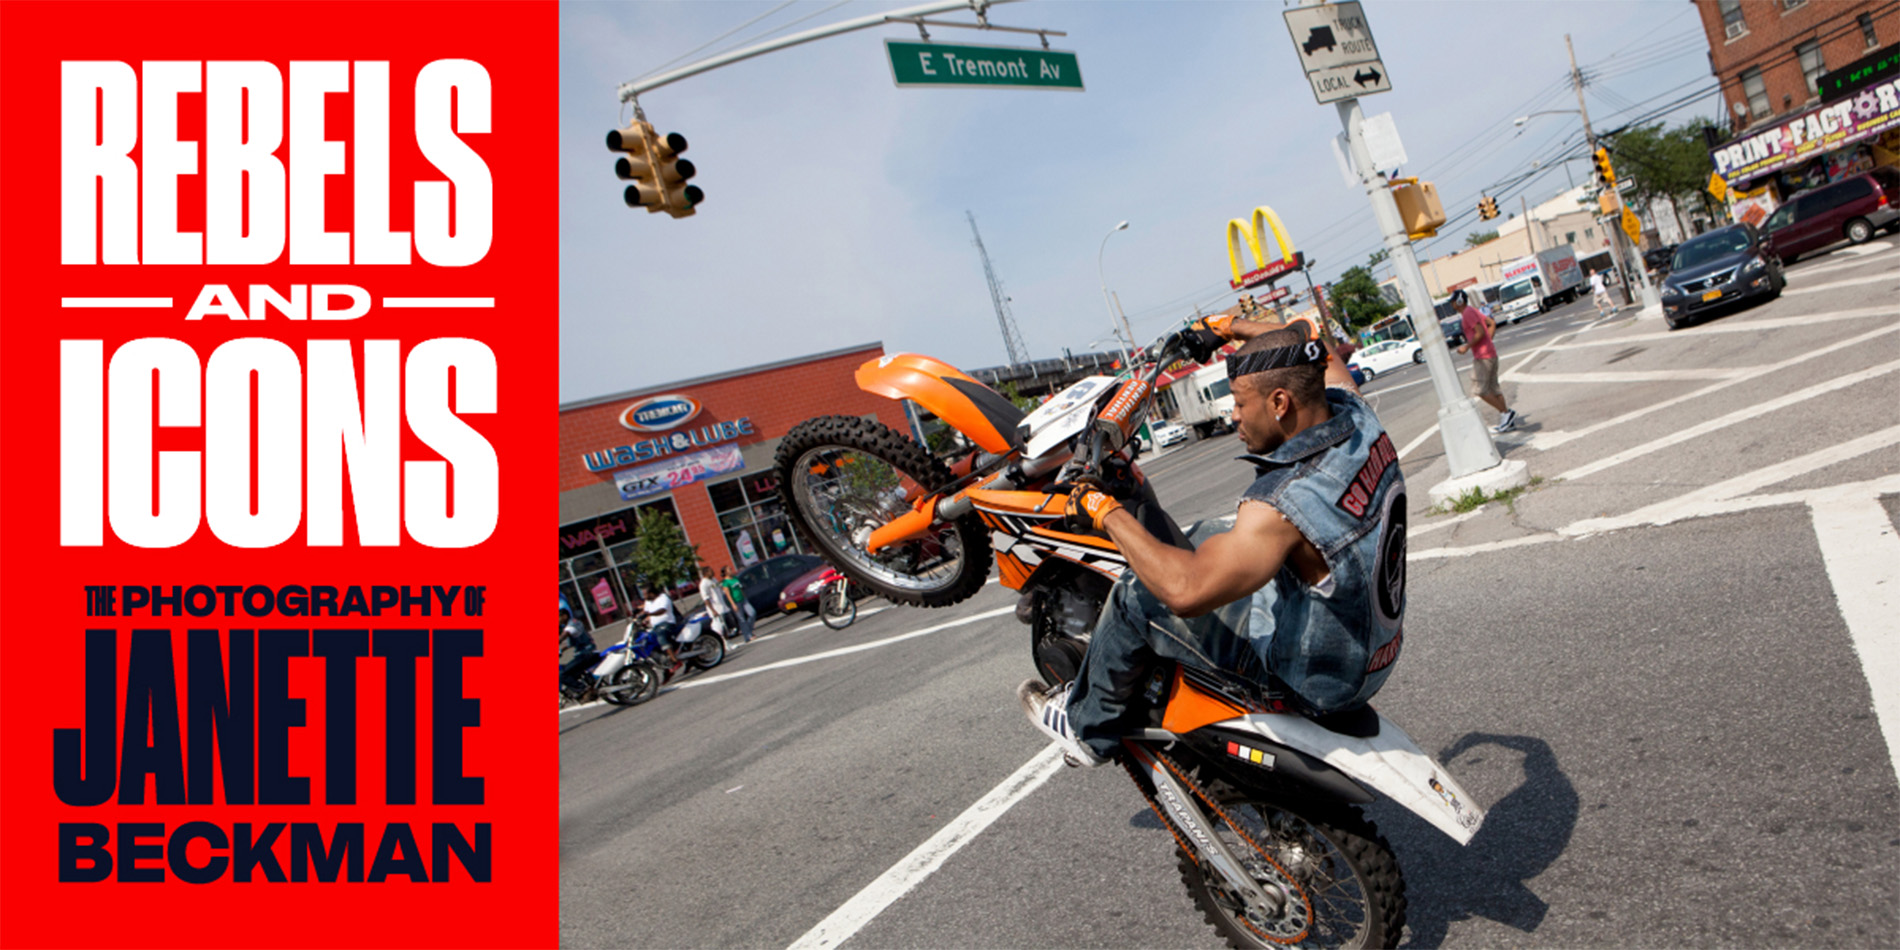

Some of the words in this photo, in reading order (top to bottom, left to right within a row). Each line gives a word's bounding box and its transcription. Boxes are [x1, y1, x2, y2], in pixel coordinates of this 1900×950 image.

[1332, 16, 1364, 32] TRUCK
[1341, 38, 1372, 55] ROUTE
[918, 52, 937, 75] E
[943, 53, 1029, 79] Tremont
[1039, 58, 1060, 80] Av
[1316, 76, 1350, 93] LOCAL
[1713, 127, 1782, 175] PRINT
[1104, 380, 1138, 418] RENTHAL
[621, 474, 660, 493] GTX
[1342, 482, 1369, 516] GO
[560, 519, 627, 549] WASH
